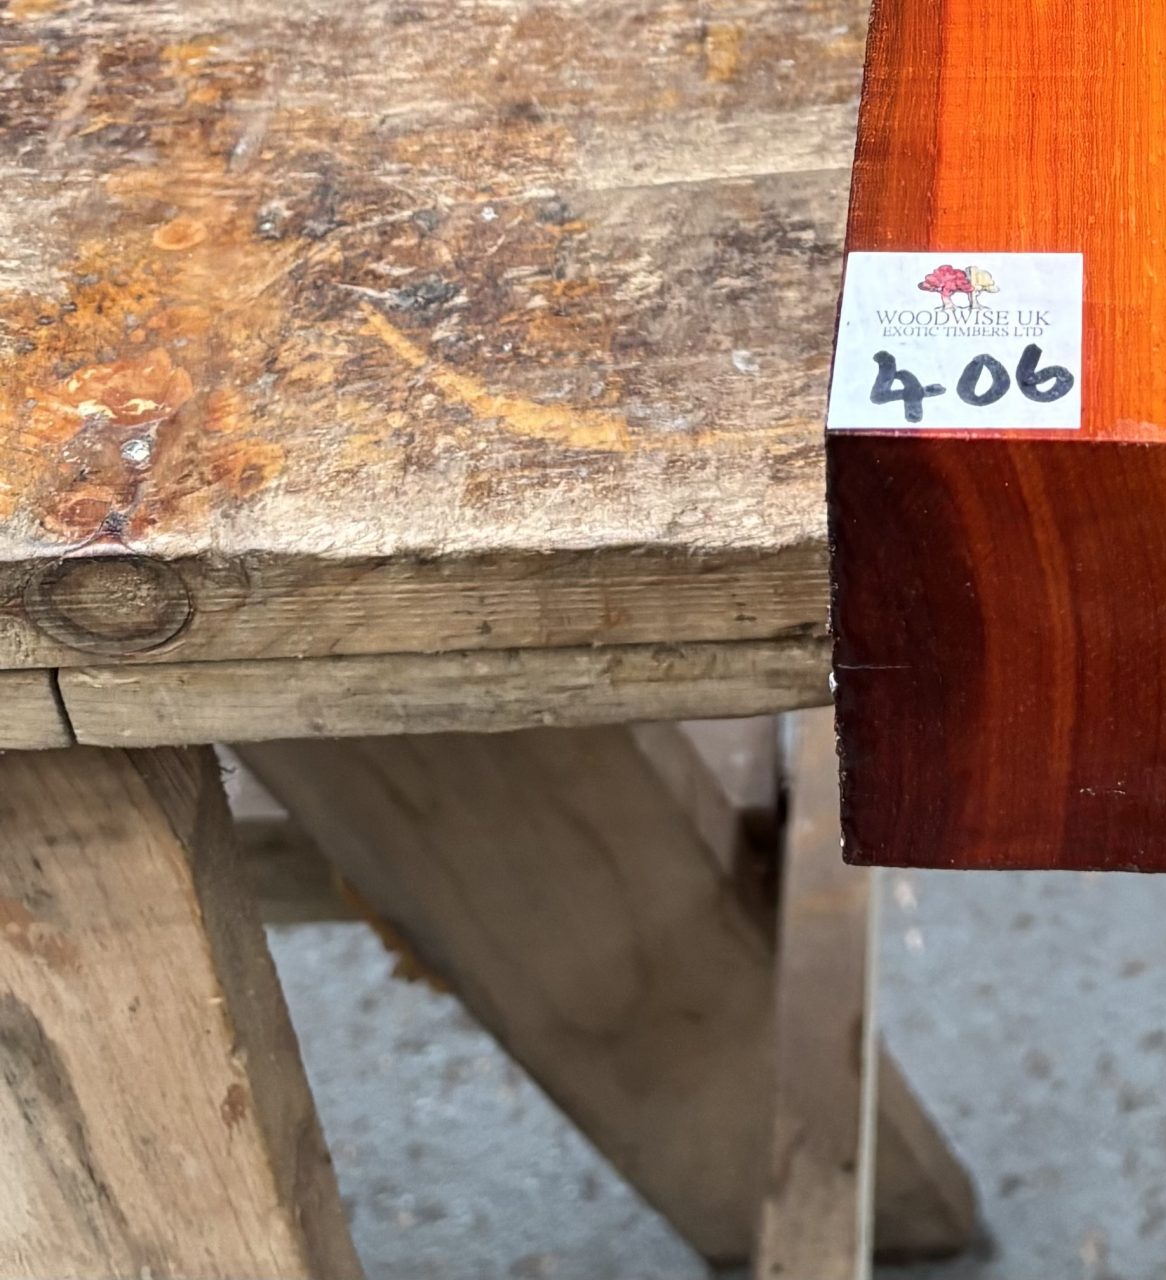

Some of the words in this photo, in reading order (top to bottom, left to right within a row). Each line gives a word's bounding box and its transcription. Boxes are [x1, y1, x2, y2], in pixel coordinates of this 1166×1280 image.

[876, 310, 1008, 326] WOODWISE
[1018, 310, 1051, 326] UK
[882, 326, 940, 337] EXOTIC
[943, 326, 1009, 337] TIMBERS
[1014, 326, 1043, 337] LTD
[870, 343, 1074, 423] 406
